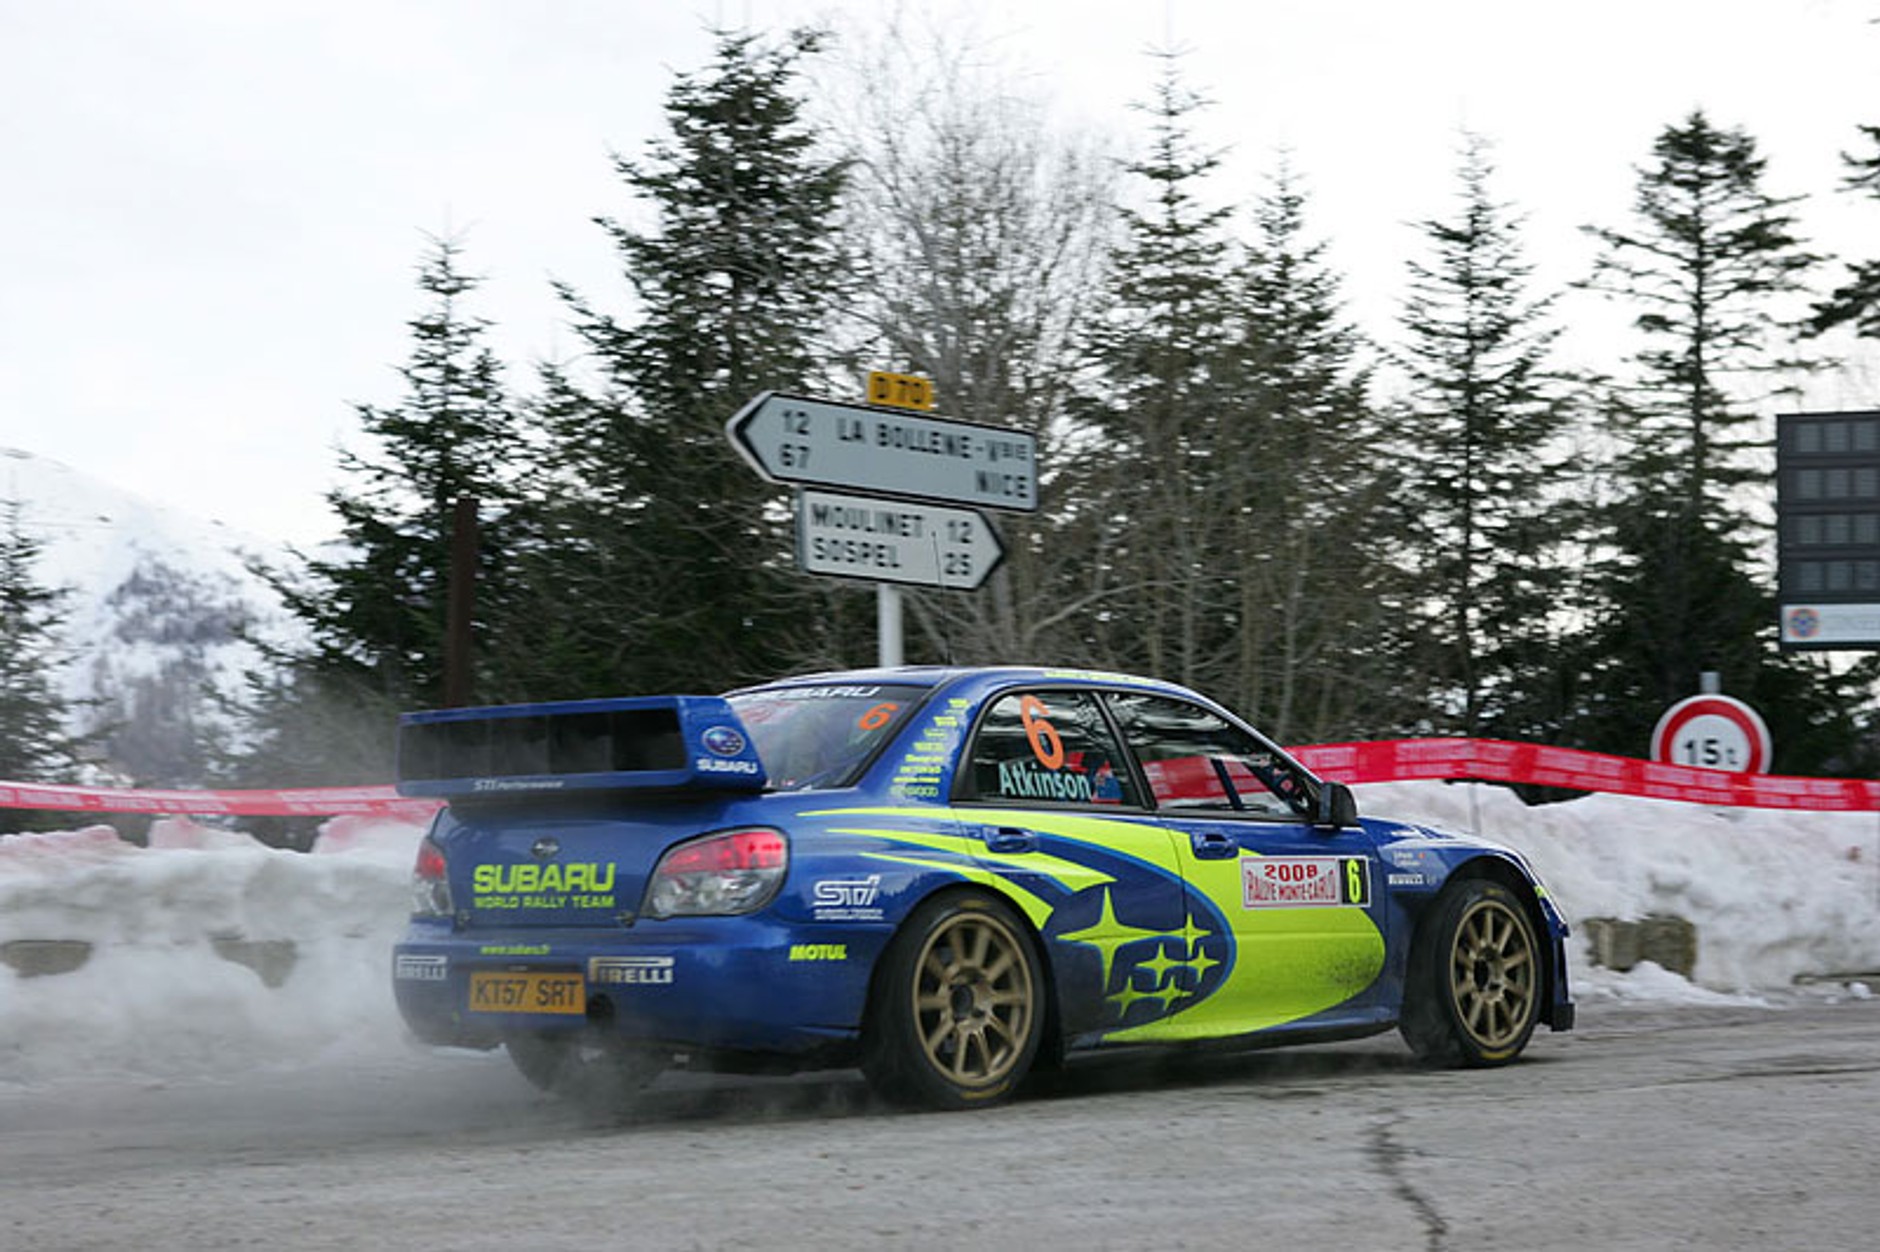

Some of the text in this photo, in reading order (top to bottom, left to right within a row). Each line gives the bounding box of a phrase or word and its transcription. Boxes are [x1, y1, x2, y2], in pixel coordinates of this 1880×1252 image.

[781, 410, 810, 436] 12
[836, 417, 866, 443] LA
[779, 443, 1029, 499] 67 NICE
[811, 503, 974, 544] MOULINET 12
[814, 537, 973, 576] SOSPEL 25
[858, 702, 899, 731] 6
[1021, 695, 1064, 769] 6
[696, 758, 758, 775] SUBARU
[999, 760, 1092, 800] Atkinson
[473, 862, 616, 893] SUBARU
[1264, 864, 1318, 882] 2008
[1346, 858, 1362, 904] 6
[474, 895, 615, 908] WORLD RALLY TEAM
[396, 954, 447, 980] PIRELLI
[790, 944, 847, 960] MOTUL
[589, 957, 675, 983] PIRELLI
[475, 979, 580, 1007] KT57 SRT
